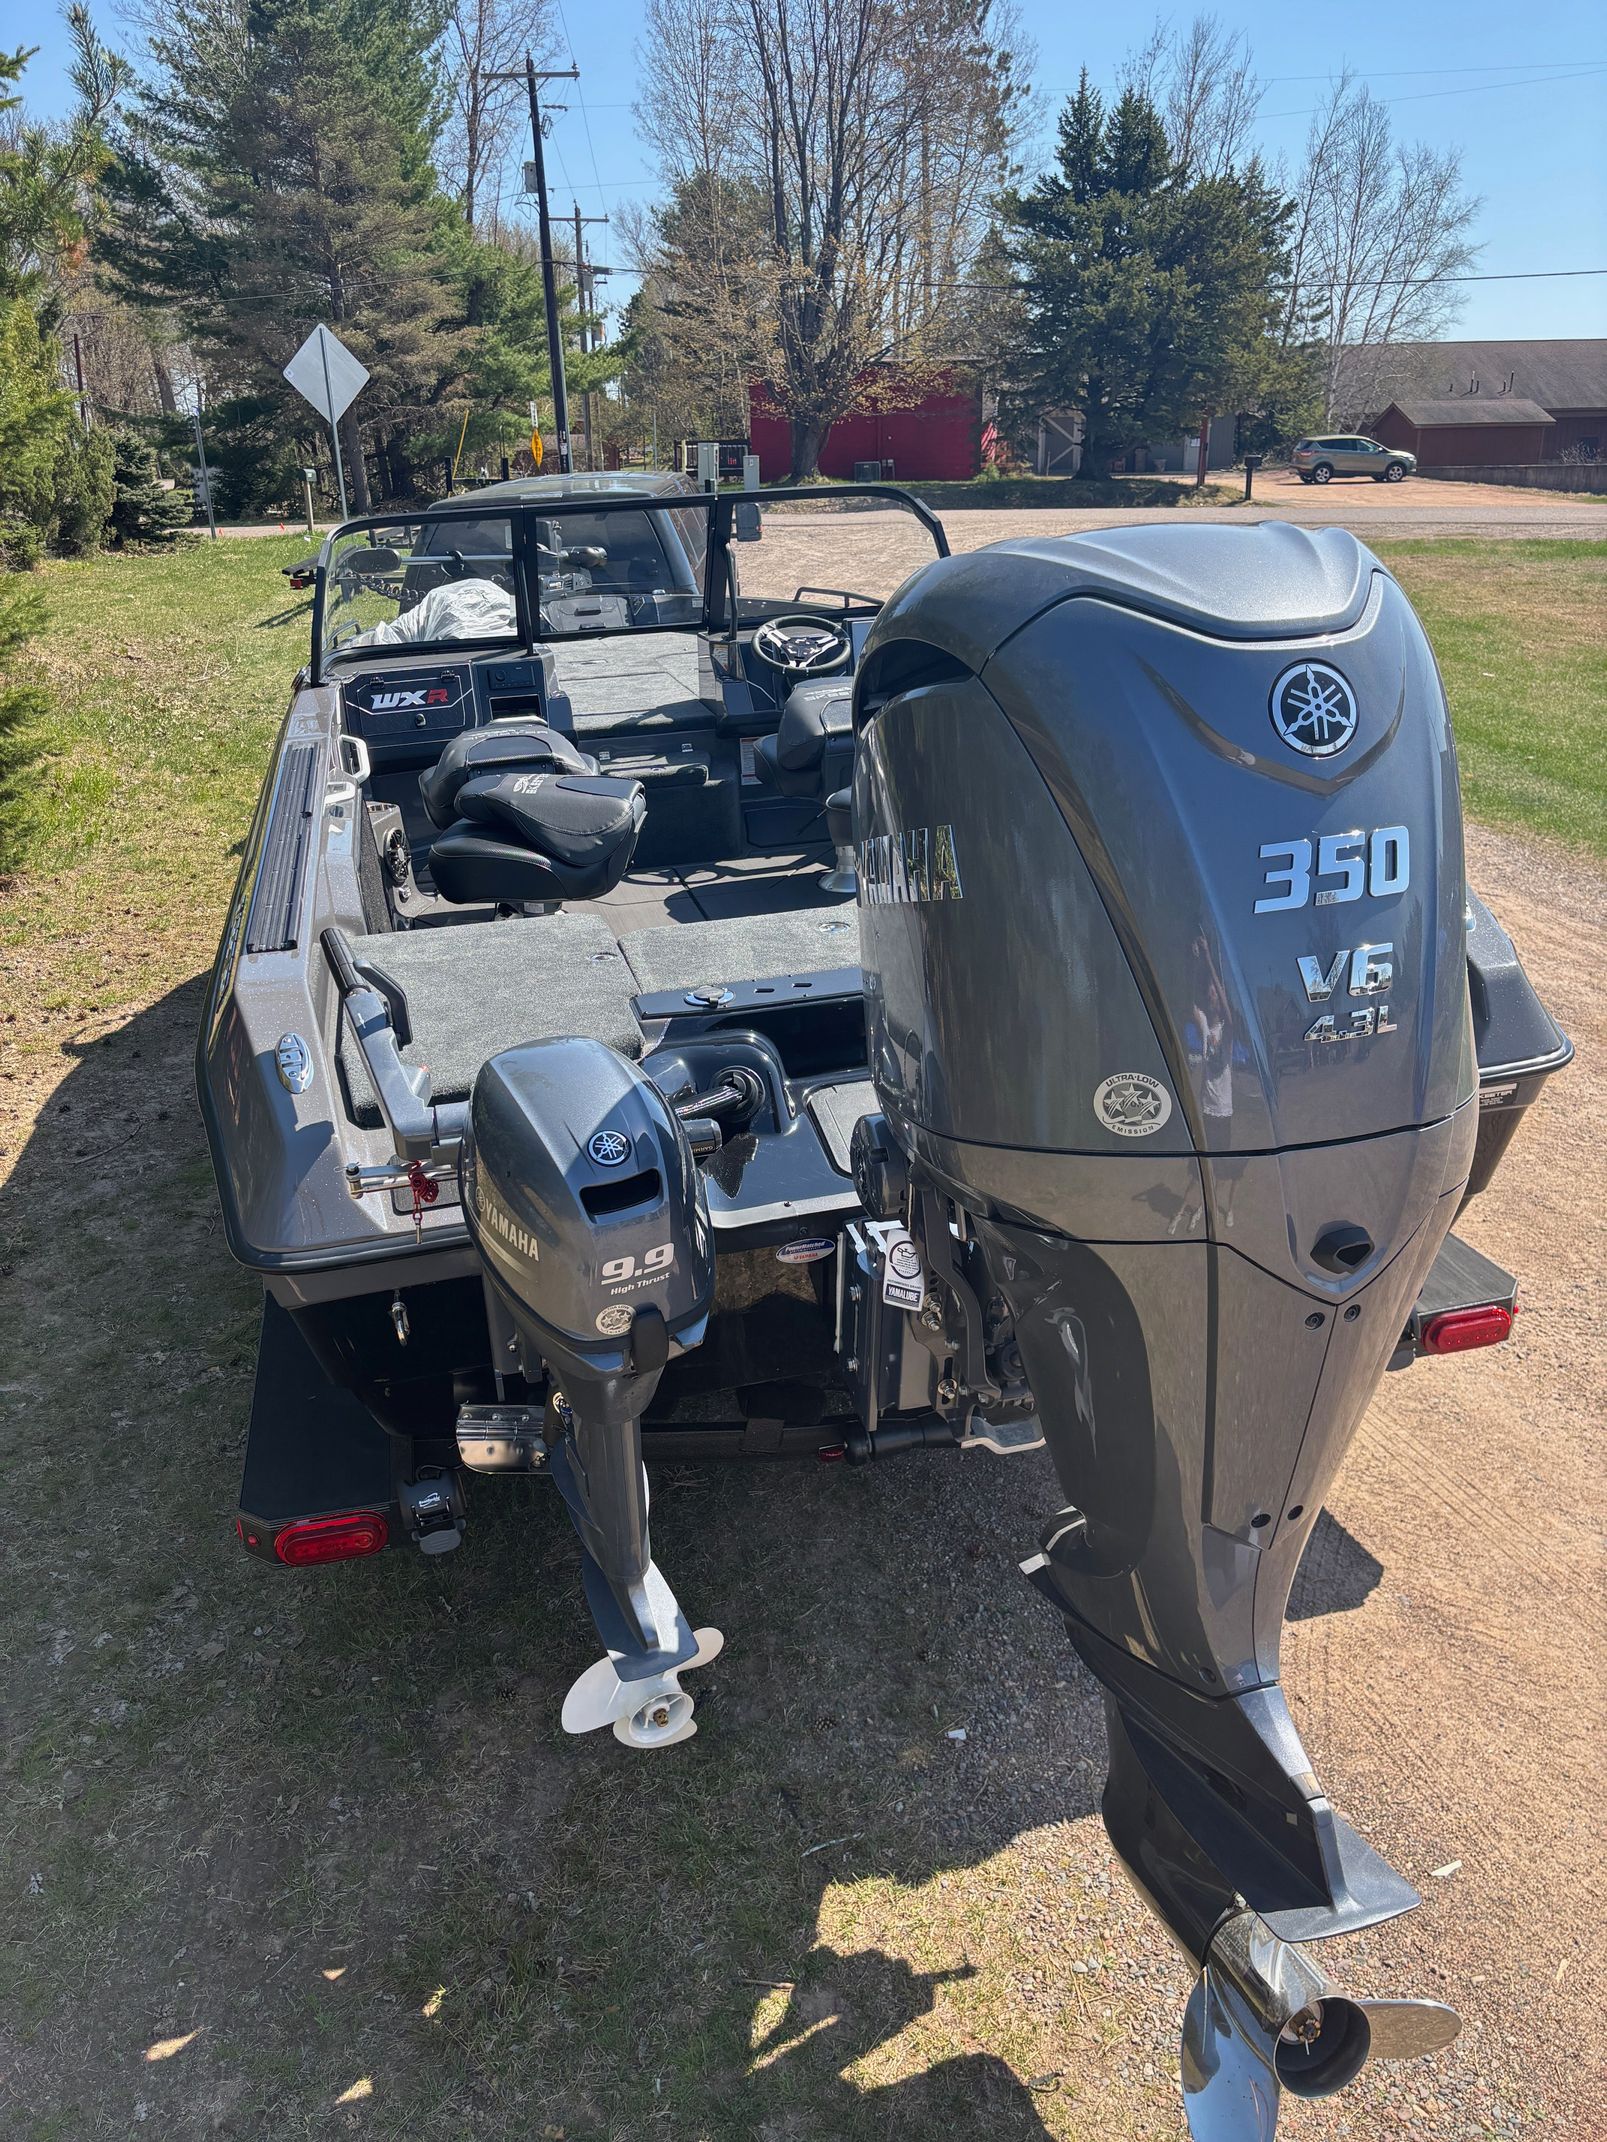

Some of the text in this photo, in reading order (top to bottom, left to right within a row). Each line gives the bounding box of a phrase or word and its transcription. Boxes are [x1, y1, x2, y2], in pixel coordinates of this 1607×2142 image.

[370, 688, 449, 710] WXR
[1253, 825, 1410, 914] 350
[1296, 942, 1394, 1003] V6
[1303, 1005, 1398, 1044] 4.3L
[1111, 1124, 1155, 1135] EMISSION
[483, 1199, 540, 1262] YAMAHA
[601, 1242, 675, 1286] 9.9
[610, 1272, 671, 1296] High Thrust
[888, 1286, 919, 1302] YAMALUBE
